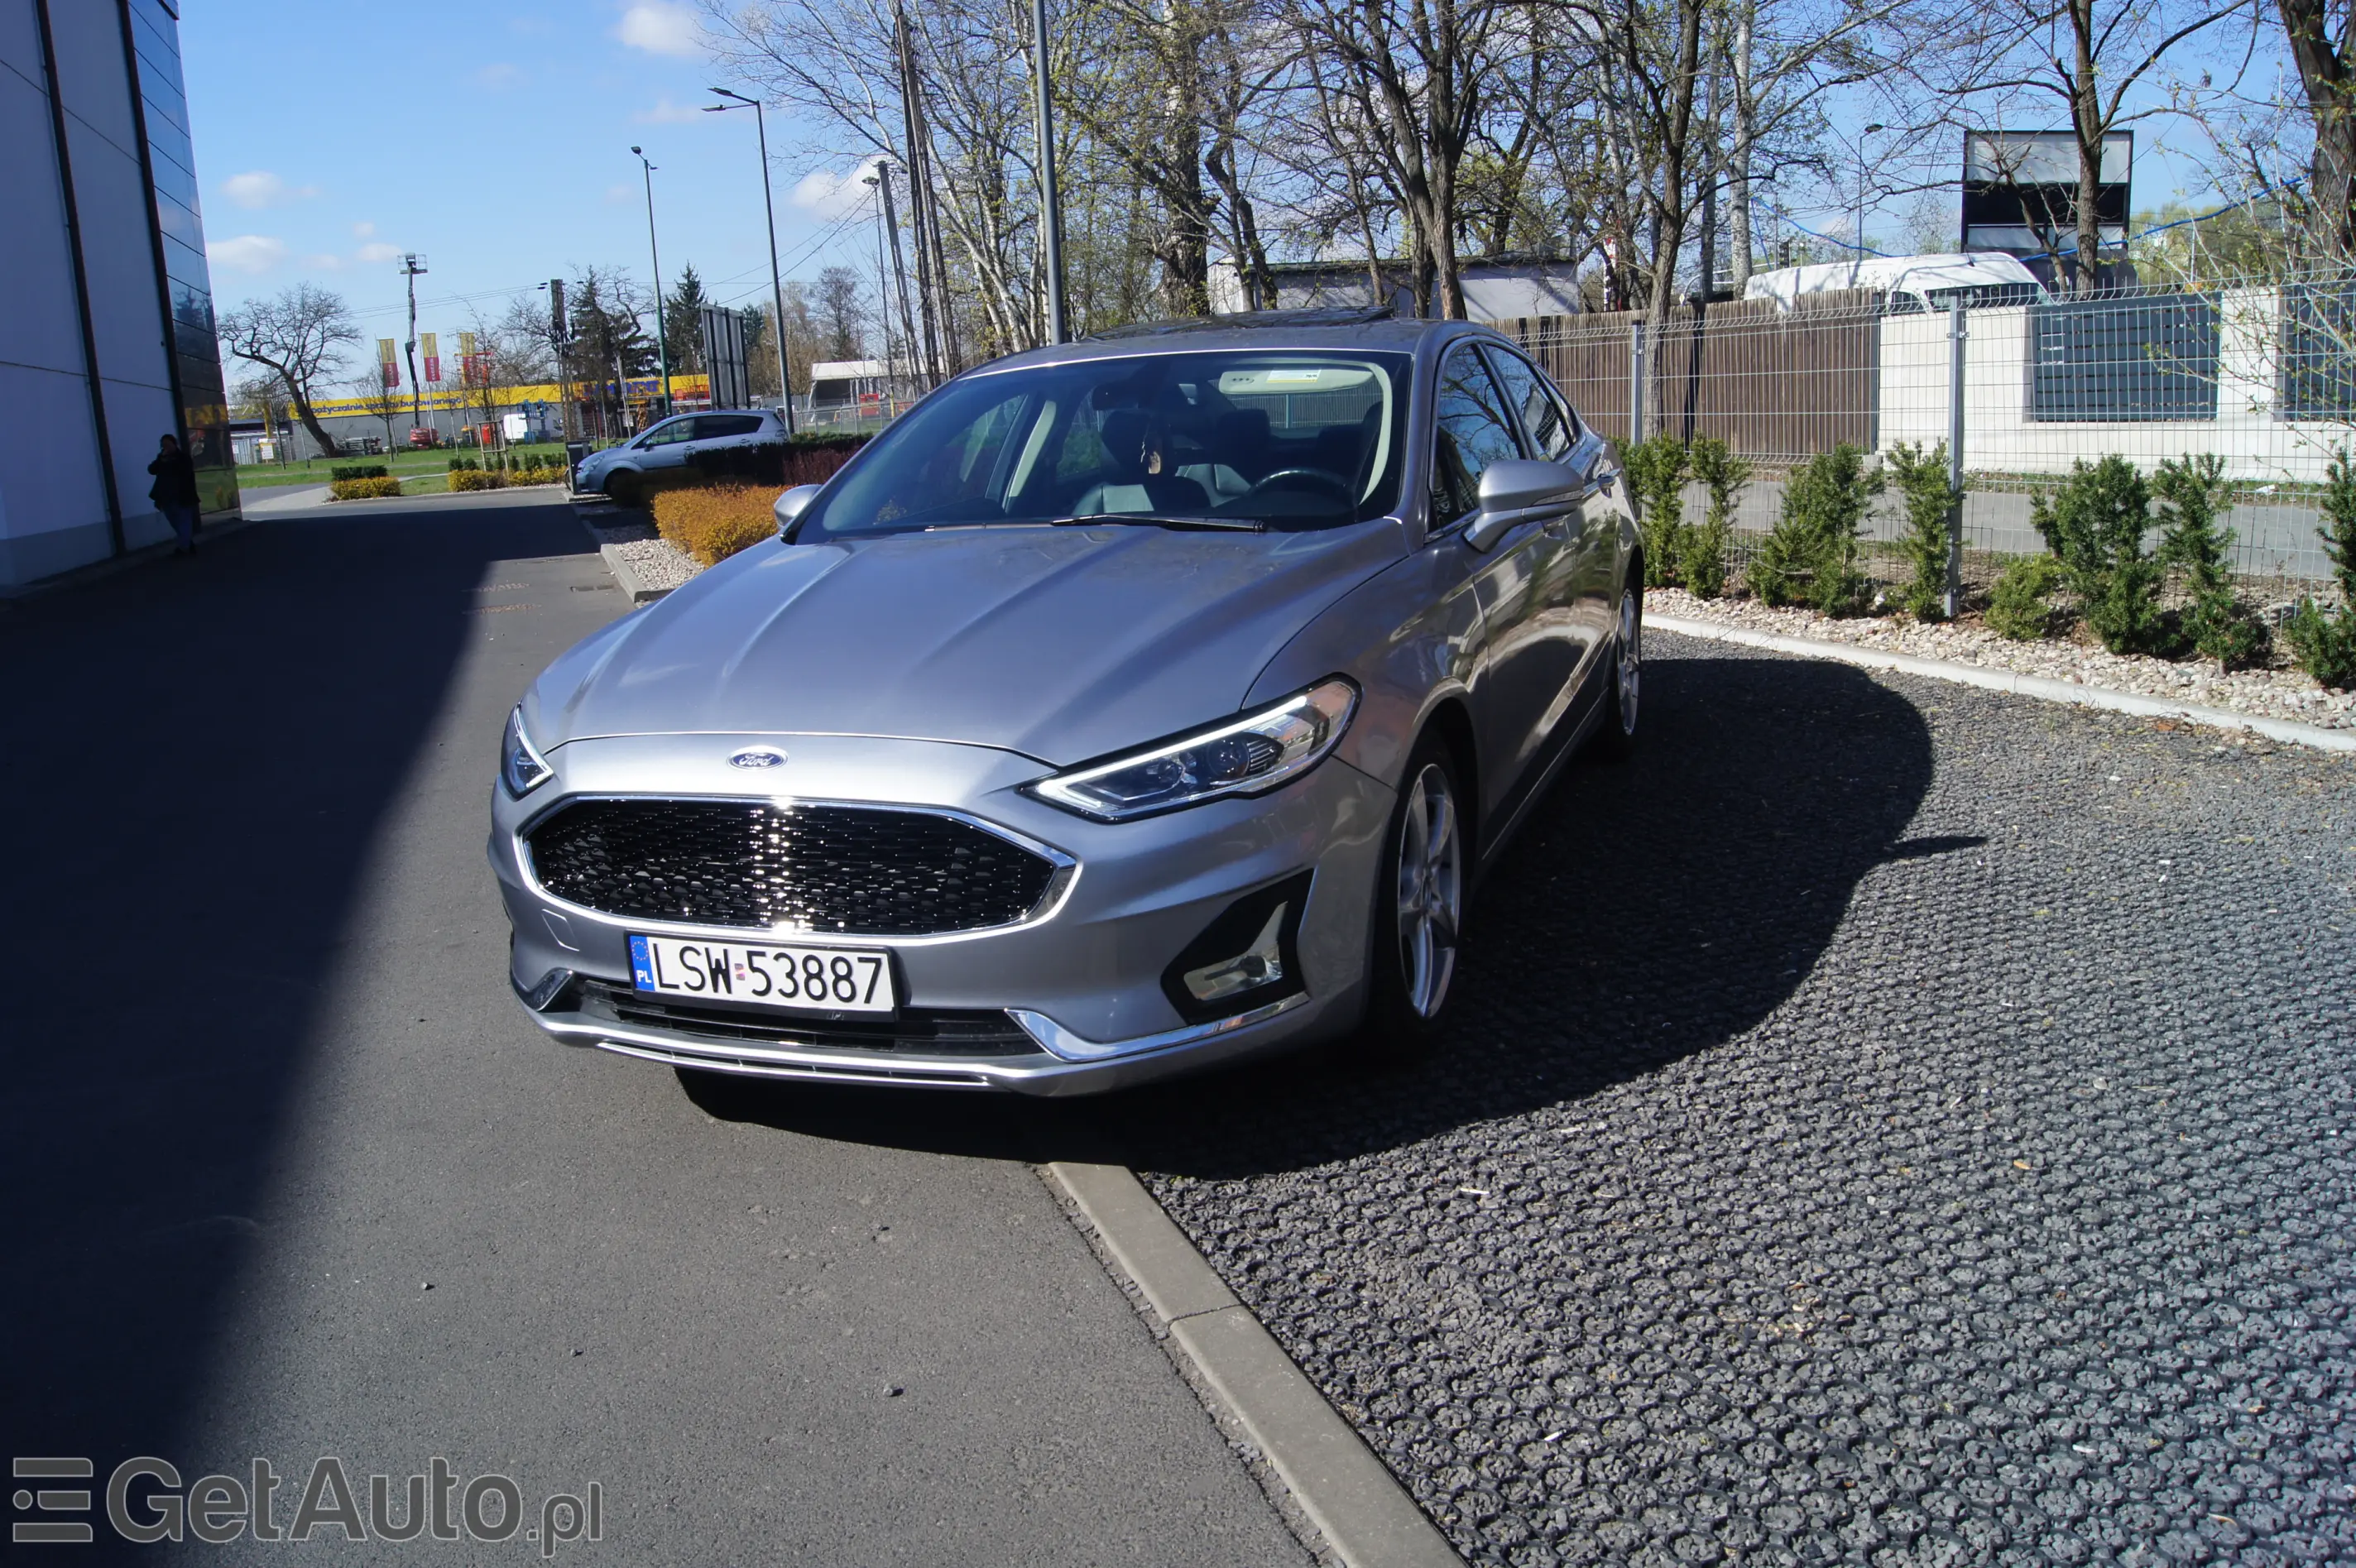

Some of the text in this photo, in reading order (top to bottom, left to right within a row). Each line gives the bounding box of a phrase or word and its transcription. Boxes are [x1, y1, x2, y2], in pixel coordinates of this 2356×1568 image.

[739, 752, 775, 766] Ford
[636, 969, 652, 983] PL
[652, 942, 883, 1005] LSW 53887
